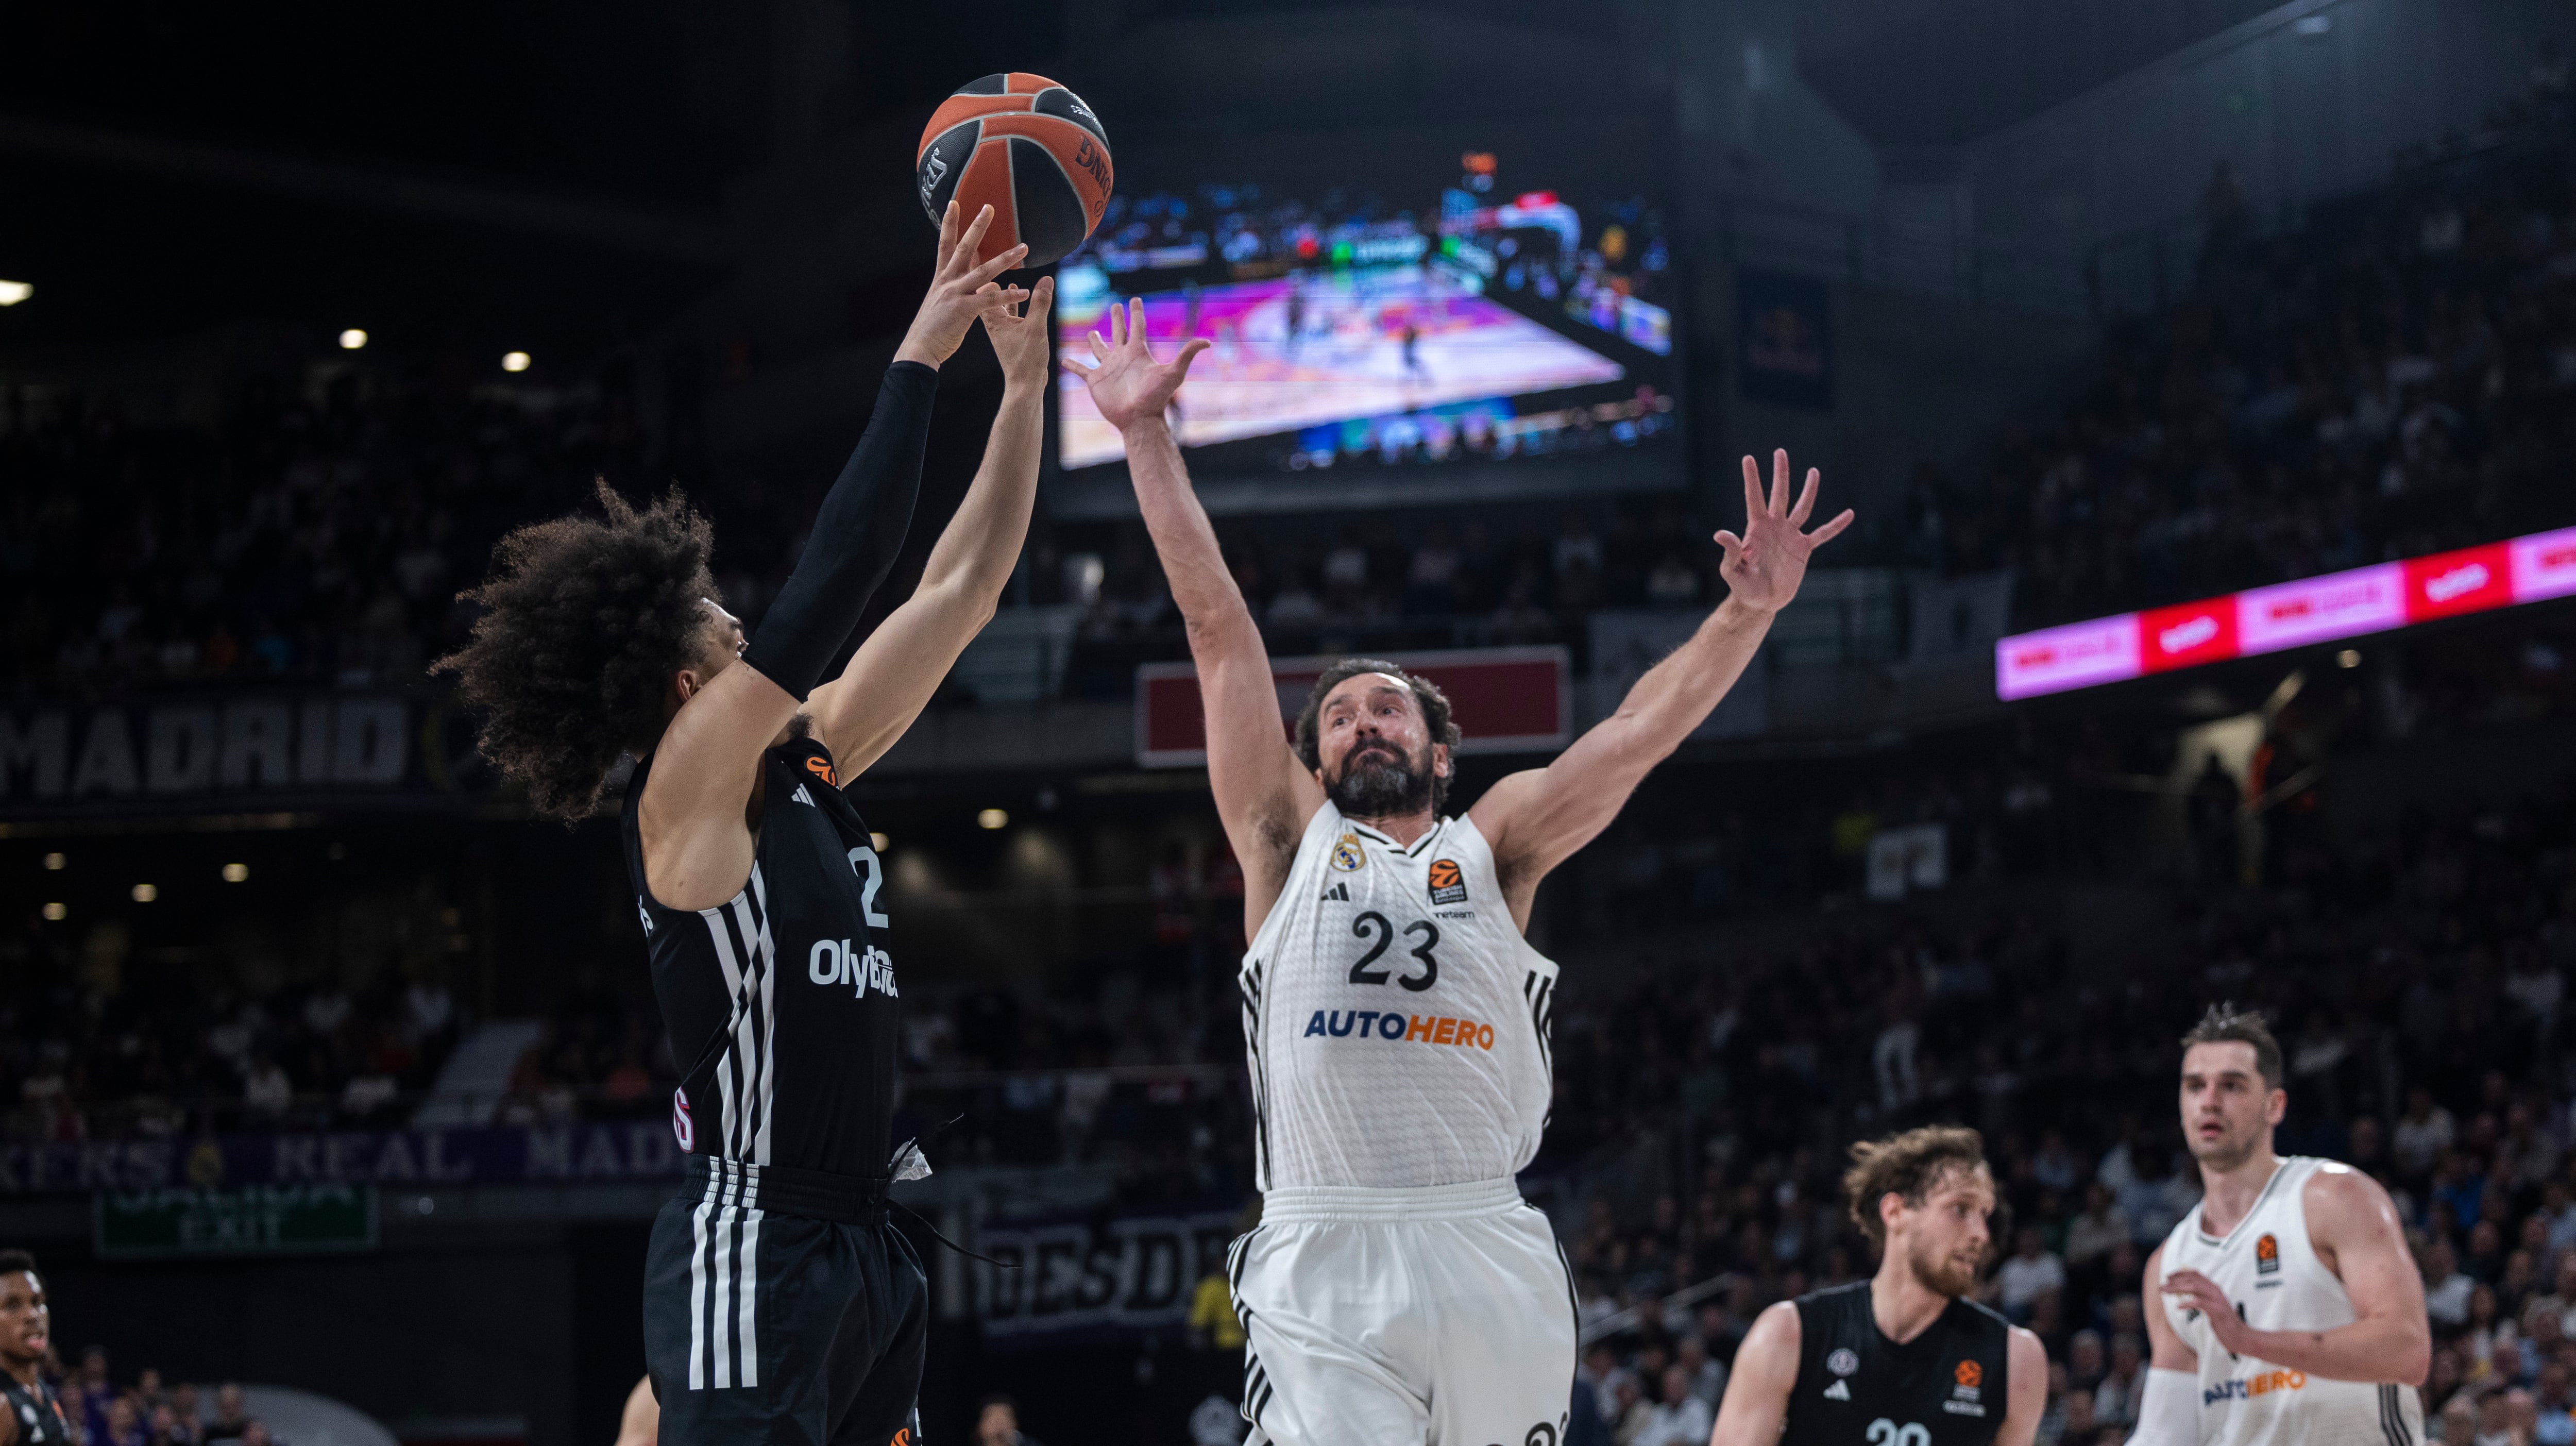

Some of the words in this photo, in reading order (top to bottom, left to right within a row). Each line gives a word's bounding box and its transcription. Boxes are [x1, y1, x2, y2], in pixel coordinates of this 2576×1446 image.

[0, 697, 411, 799] MADRID
[1349, 910, 1440, 992] 23
[1304, 1010, 1495, 1051] AUTOHERO
[273, 1130, 473, 1184] REAL
[527, 1125, 674, 1178] MAD
[177, 1214, 281, 1246] EXIT
